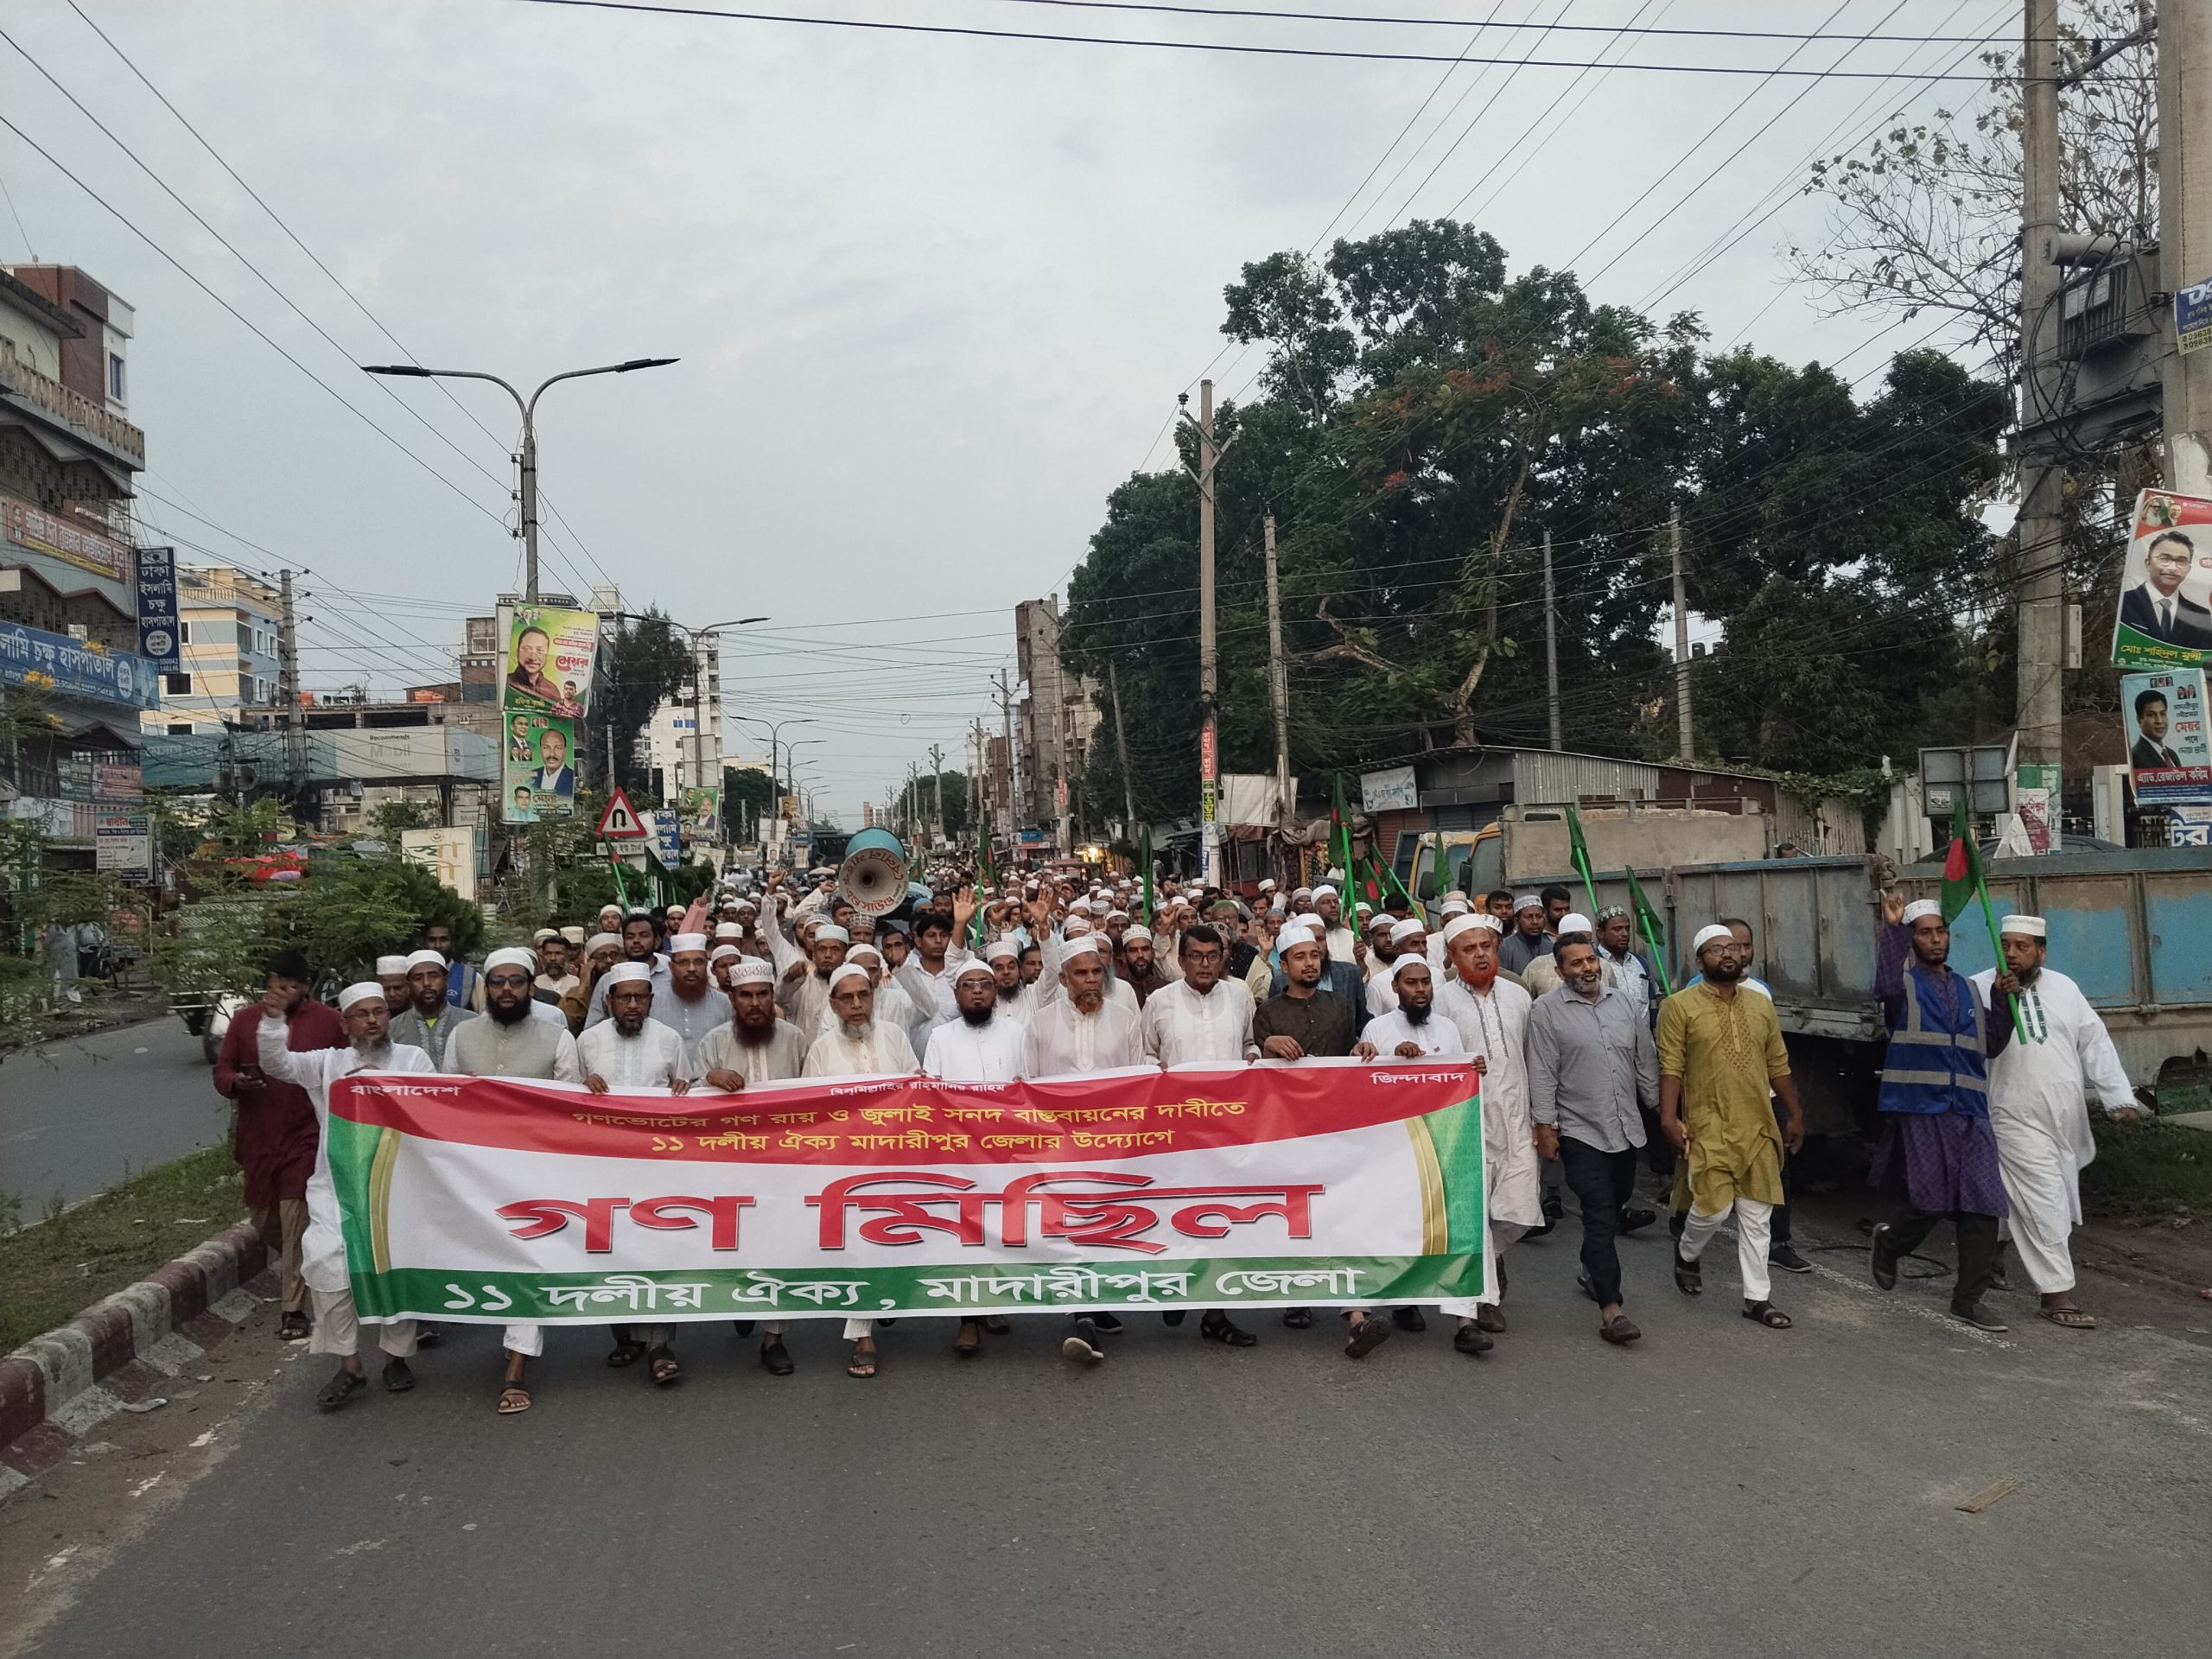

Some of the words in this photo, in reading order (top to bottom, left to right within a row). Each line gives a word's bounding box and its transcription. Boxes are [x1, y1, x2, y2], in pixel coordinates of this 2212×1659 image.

[140, 565, 170, 577] ঢাকা
[138, 580, 173, 596] ইসলামি
[147, 599, 167, 613] চক্ষু
[140, 615, 175, 628] হাসপাতাল
[32, 640, 55, 674] চক্ষু
[58, 645, 116, 680] হাসপাতাল
[2175, 721, 2201, 734] মেয়র
[370, 744, 411, 758] Mbil
[1369, 1071, 1467, 1084] জিন্দাবাদ
[350, 1084, 462, 1096] বাংলাদেশ
[572, 1111, 709, 1128] গণভোটের
[720, 1112, 760, 1127] গণ
[769, 1110, 817, 1125] রায়
[827, 1109, 850, 1122] ও
[858, 1103, 936, 1126] জুলাই
[942, 1107, 1005, 1123] সনদ
[1014, 1104, 1148, 1123] বাস্তবায়নের
[1157, 1097, 1248, 1119] দাবীতে
[651, 1135, 684, 1152] ১১
[695, 1131, 770, 1151] দলীয়
[778, 1129, 841, 1151] ঐক্য
[847, 1128, 973, 1152] মাদারীপুর
[979, 1131, 1065, 1150] জেলার
[1071, 1127, 1175, 1148] উদ্যোগে
[496, 1194, 757, 1255] গণ
[804, 1171, 1325, 1255] মিছিল
[442, 1281, 513, 1313] ১১
[537, 1274, 714, 1313] দলীয়
[914, 1265, 1197, 1305] মাদারীপুর
[1214, 1267, 1367, 1296] জেলা
